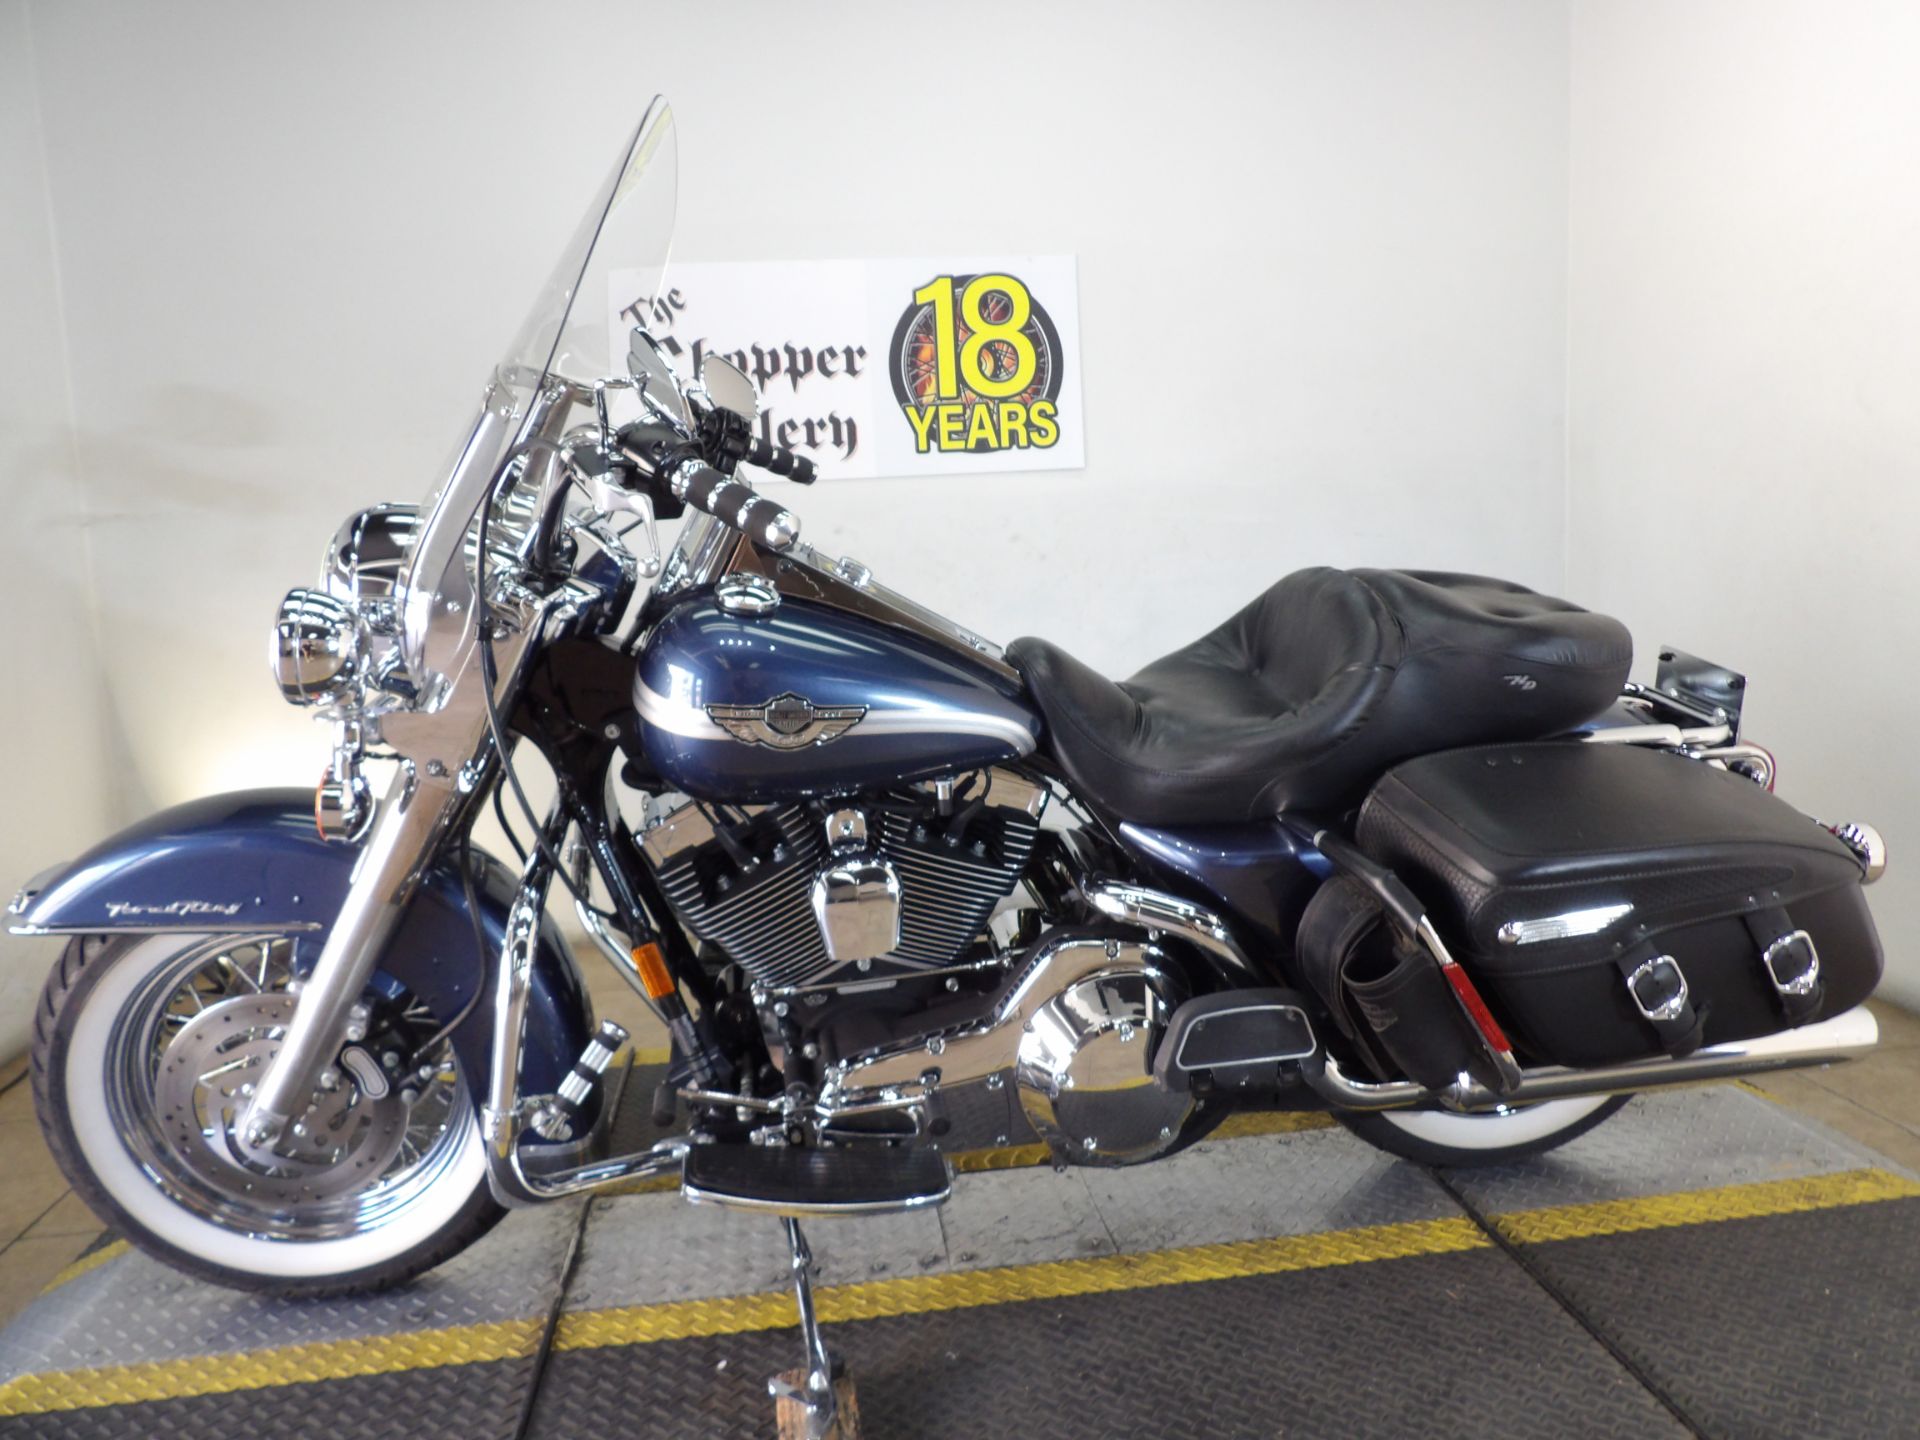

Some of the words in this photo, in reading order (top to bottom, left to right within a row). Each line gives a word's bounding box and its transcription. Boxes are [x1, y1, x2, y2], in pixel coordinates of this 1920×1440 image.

[620, 288, 686, 330] The
[914, 273, 1036, 398] 18
[904, 400, 1059, 453] YEARS
